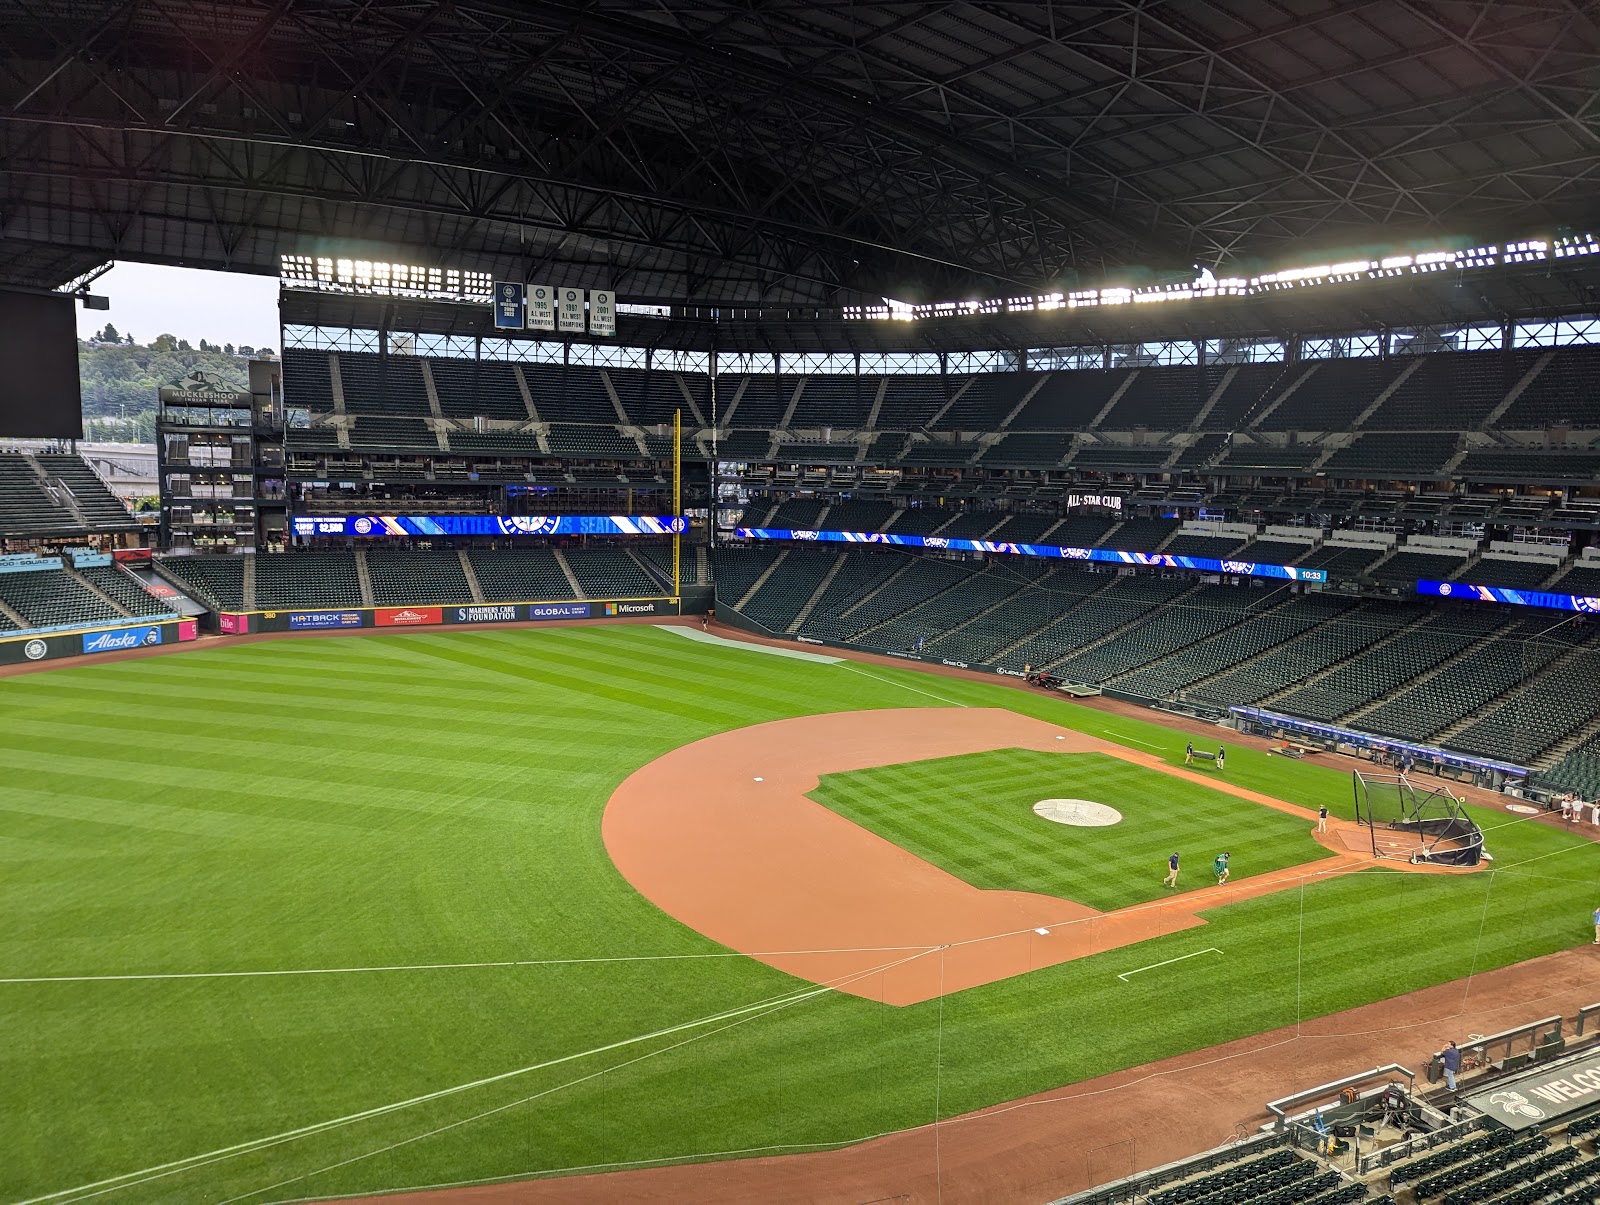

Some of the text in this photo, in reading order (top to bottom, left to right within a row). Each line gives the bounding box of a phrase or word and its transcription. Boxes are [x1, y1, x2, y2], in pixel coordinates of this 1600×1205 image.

[534, 302, 547, 310] 1995
[172, 390, 240, 400] MUCKLESHOOT
[1102, 496, 1121, 510] CLUB
[1302, 571, 1320, 580] 10:33
[619, 604, 654, 612] Microsoft
[291, 614, 340, 622] HATBACK
[469, 612, 515, 621] FOUNDATION
[88, 633, 136, 650] Alaska
